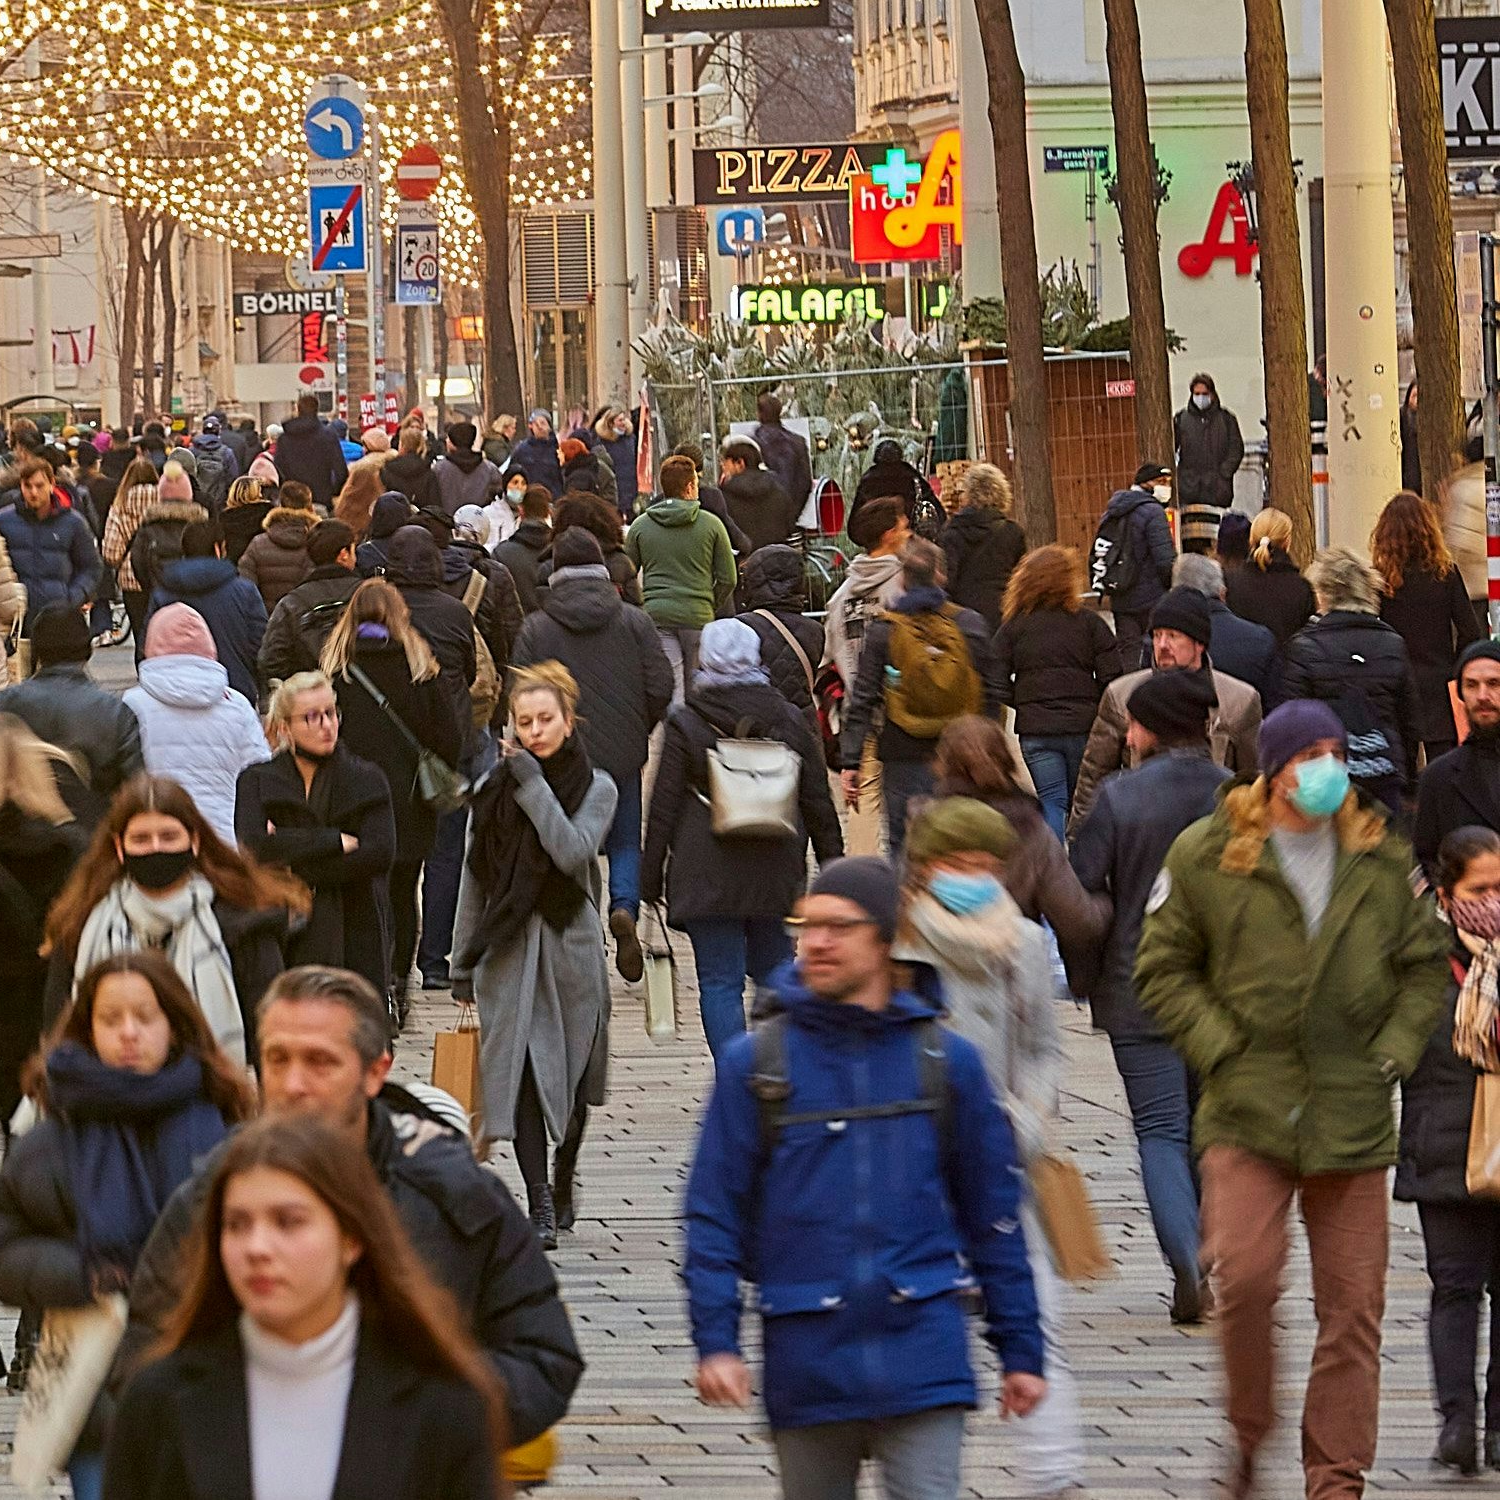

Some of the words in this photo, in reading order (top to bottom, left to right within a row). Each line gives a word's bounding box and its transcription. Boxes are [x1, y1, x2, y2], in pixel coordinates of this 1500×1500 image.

[1441, 57, 1500, 131] KI
[716, 146, 864, 194] PIZZA
[724, 218, 756, 250] U
[421, 262, 434, 277] 20
[242, 291, 338, 314] BÖHNEL
[739, 287, 884, 321] FALAFEL
[361, 397, 397, 413] Kroen
